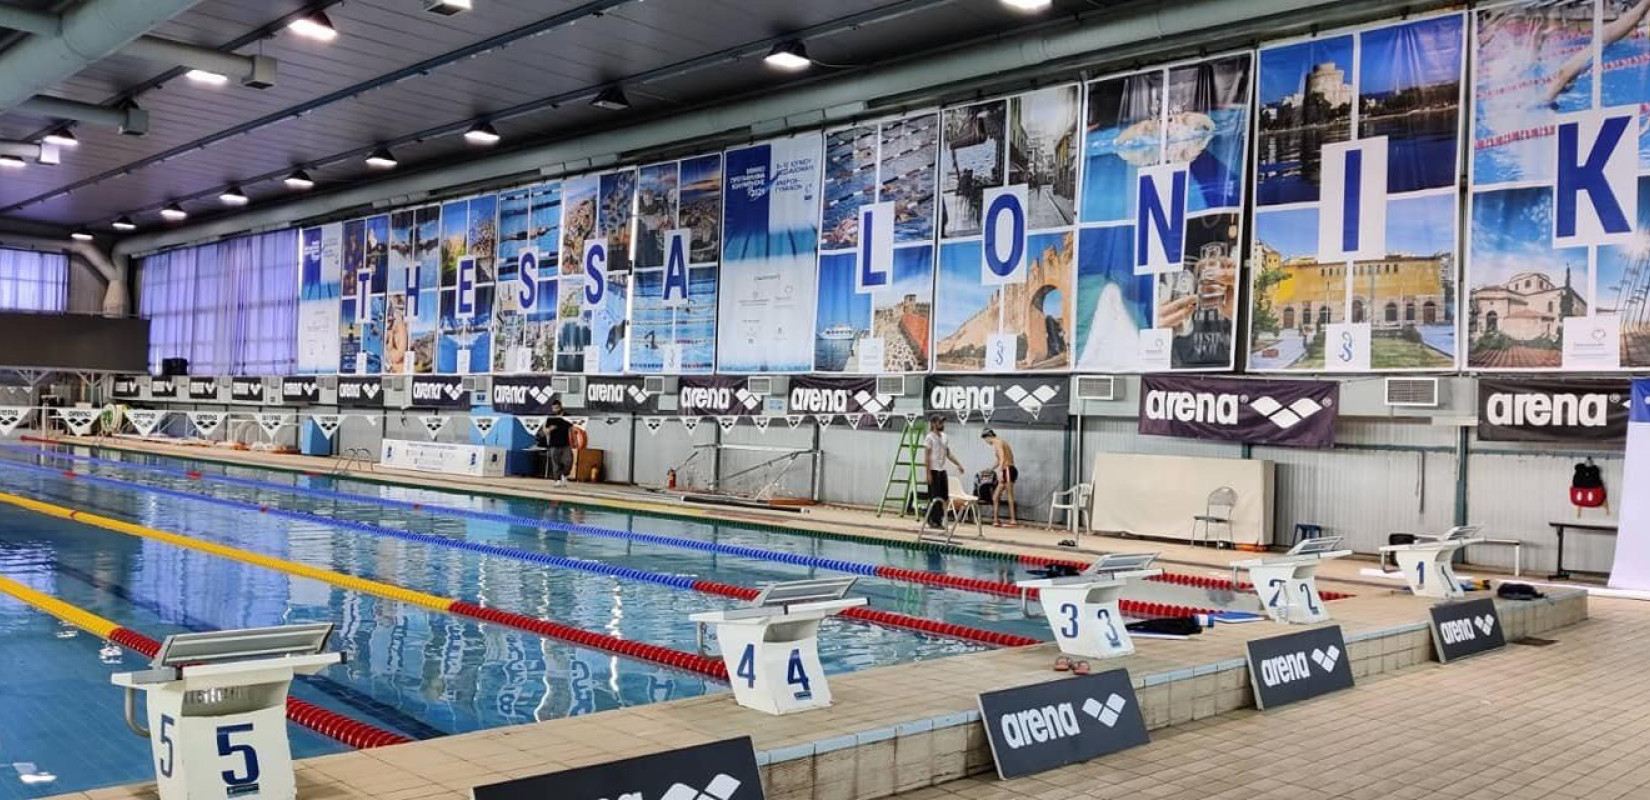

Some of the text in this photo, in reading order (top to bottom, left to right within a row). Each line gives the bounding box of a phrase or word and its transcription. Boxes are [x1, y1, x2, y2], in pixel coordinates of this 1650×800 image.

[358, 115, 1633, 319] T H E S S A L O N I K
[413, 382, 442, 400] arena
[494, 384, 525, 404] arena
[588, 383, 624, 402] arena
[681, 386, 730, 409] arena
[790, 386, 847, 412] arena
[931, 385, 994, 410] arena
[1145, 389, 1238, 425] arena
[1487, 393, 1607, 426] arena
[1416, 561, 1425, 586] 1
[1300, 583, 1318, 612] 2
[1060, 603, 1079, 638] 3
[1097, 608, 1120, 642] 3
[1440, 617, 1475, 645] arena
[737, 643, 756, 689] 4
[787, 649, 811, 690] 4
[1261, 651, 1310, 687] arena
[1001, 702, 1081, 749] arena
[160, 714, 174, 778] 5
[216, 722, 260, 785] 5
